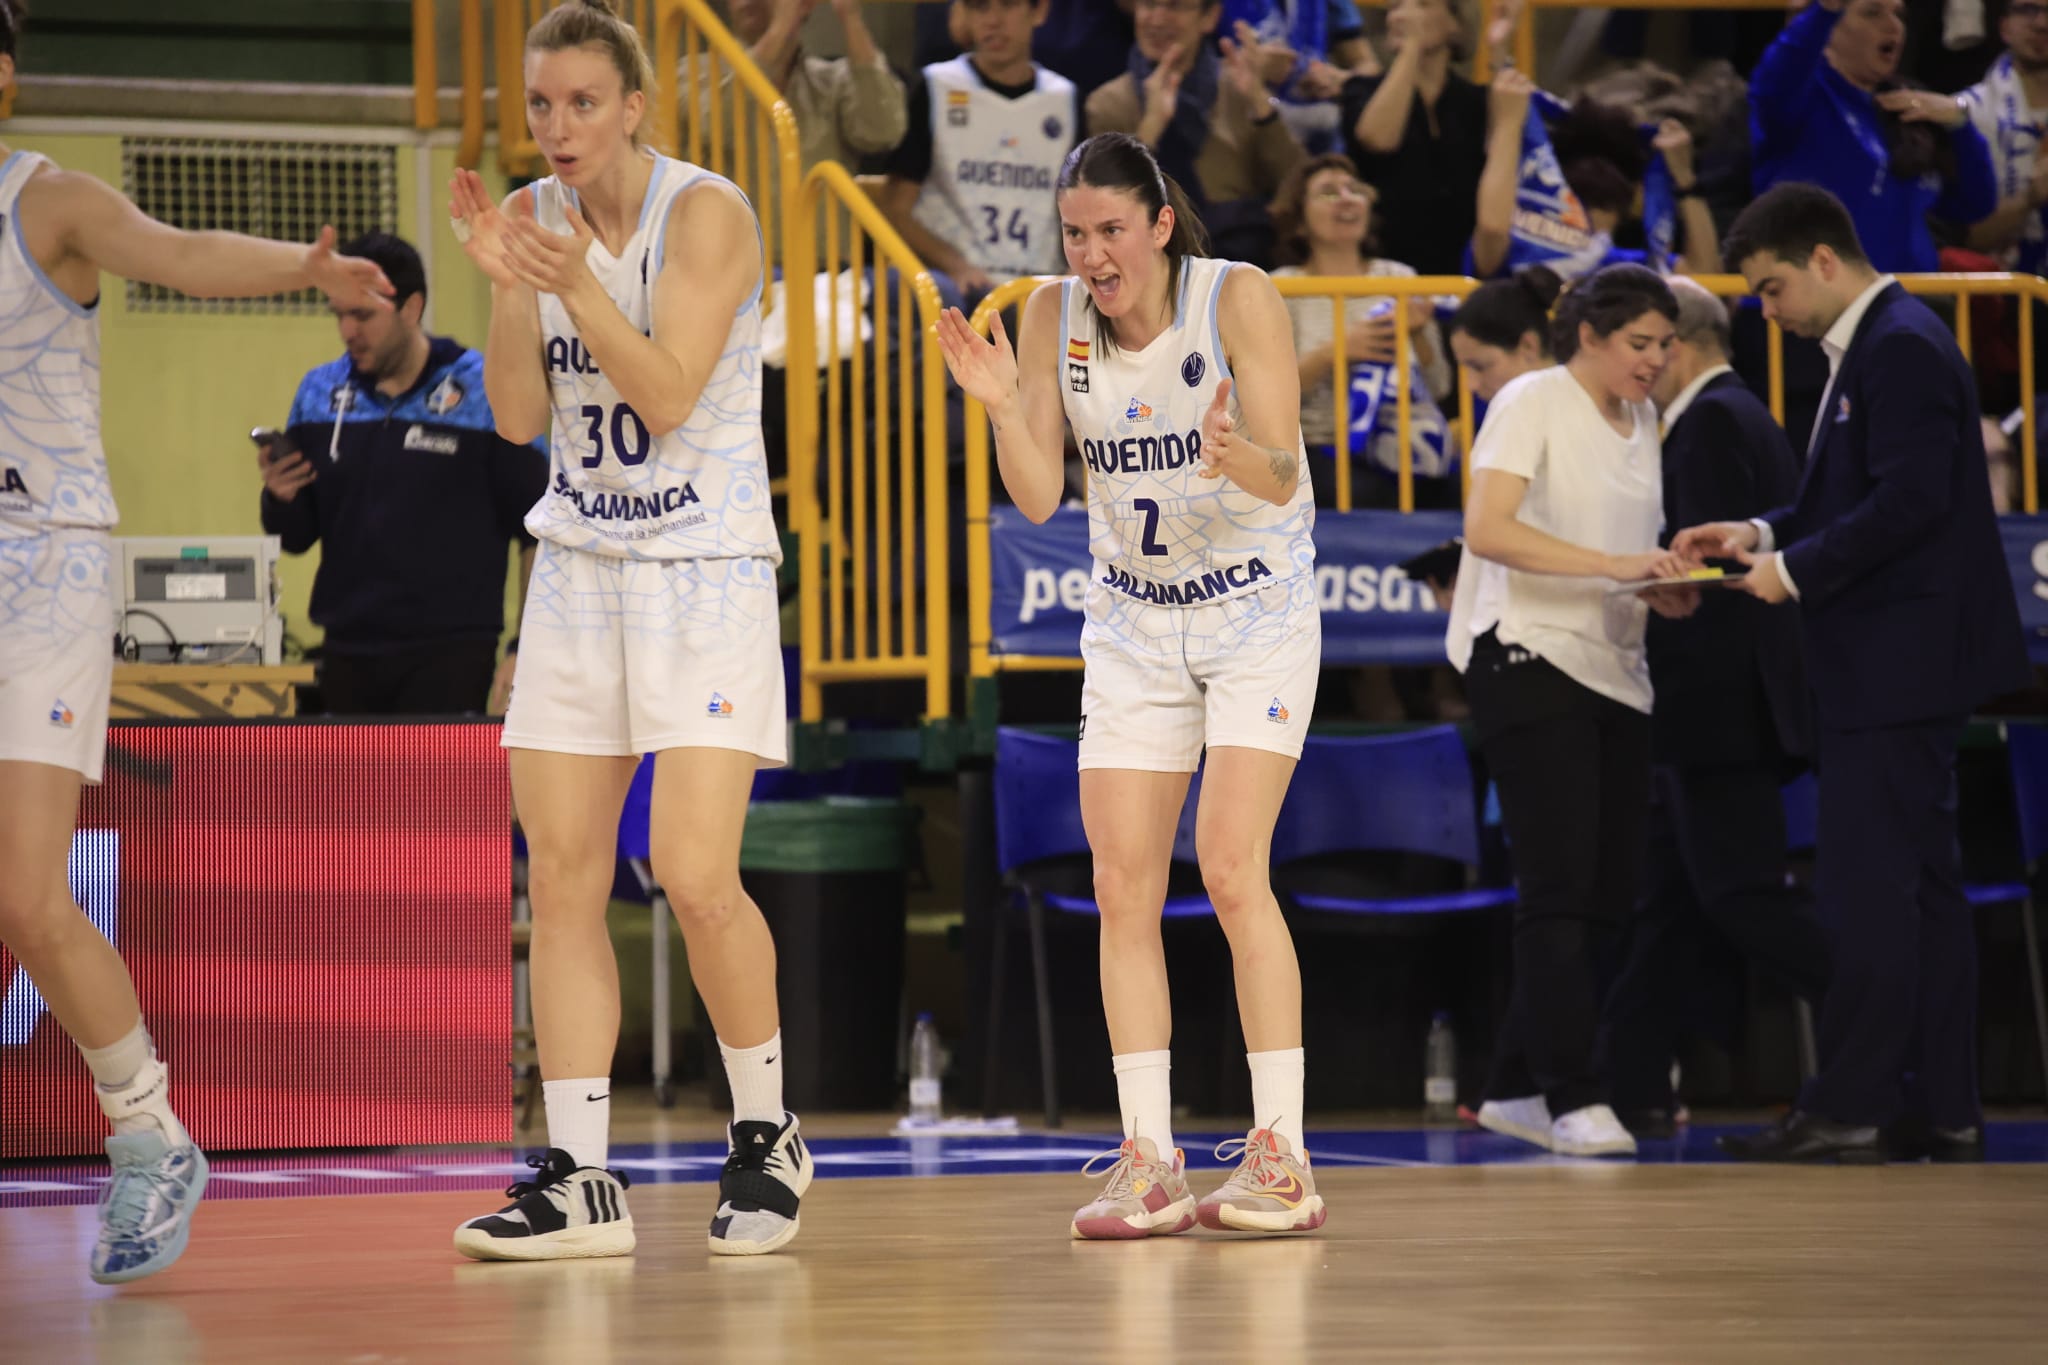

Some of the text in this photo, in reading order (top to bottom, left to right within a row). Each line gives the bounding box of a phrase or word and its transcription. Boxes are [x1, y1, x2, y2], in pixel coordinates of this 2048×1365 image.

[957, 160, 1050, 189] AVENIDA
[981, 205, 1028, 249] 34
[581, 402, 650, 468] 30
[1084, 429, 1201, 473] AVENIDA
[553, 472, 700, 521] SALAMANCA
[1133, 498, 1168, 556] 2
[1019, 567, 1089, 624] pe
[1102, 557, 1272, 605] SALAMANCA
